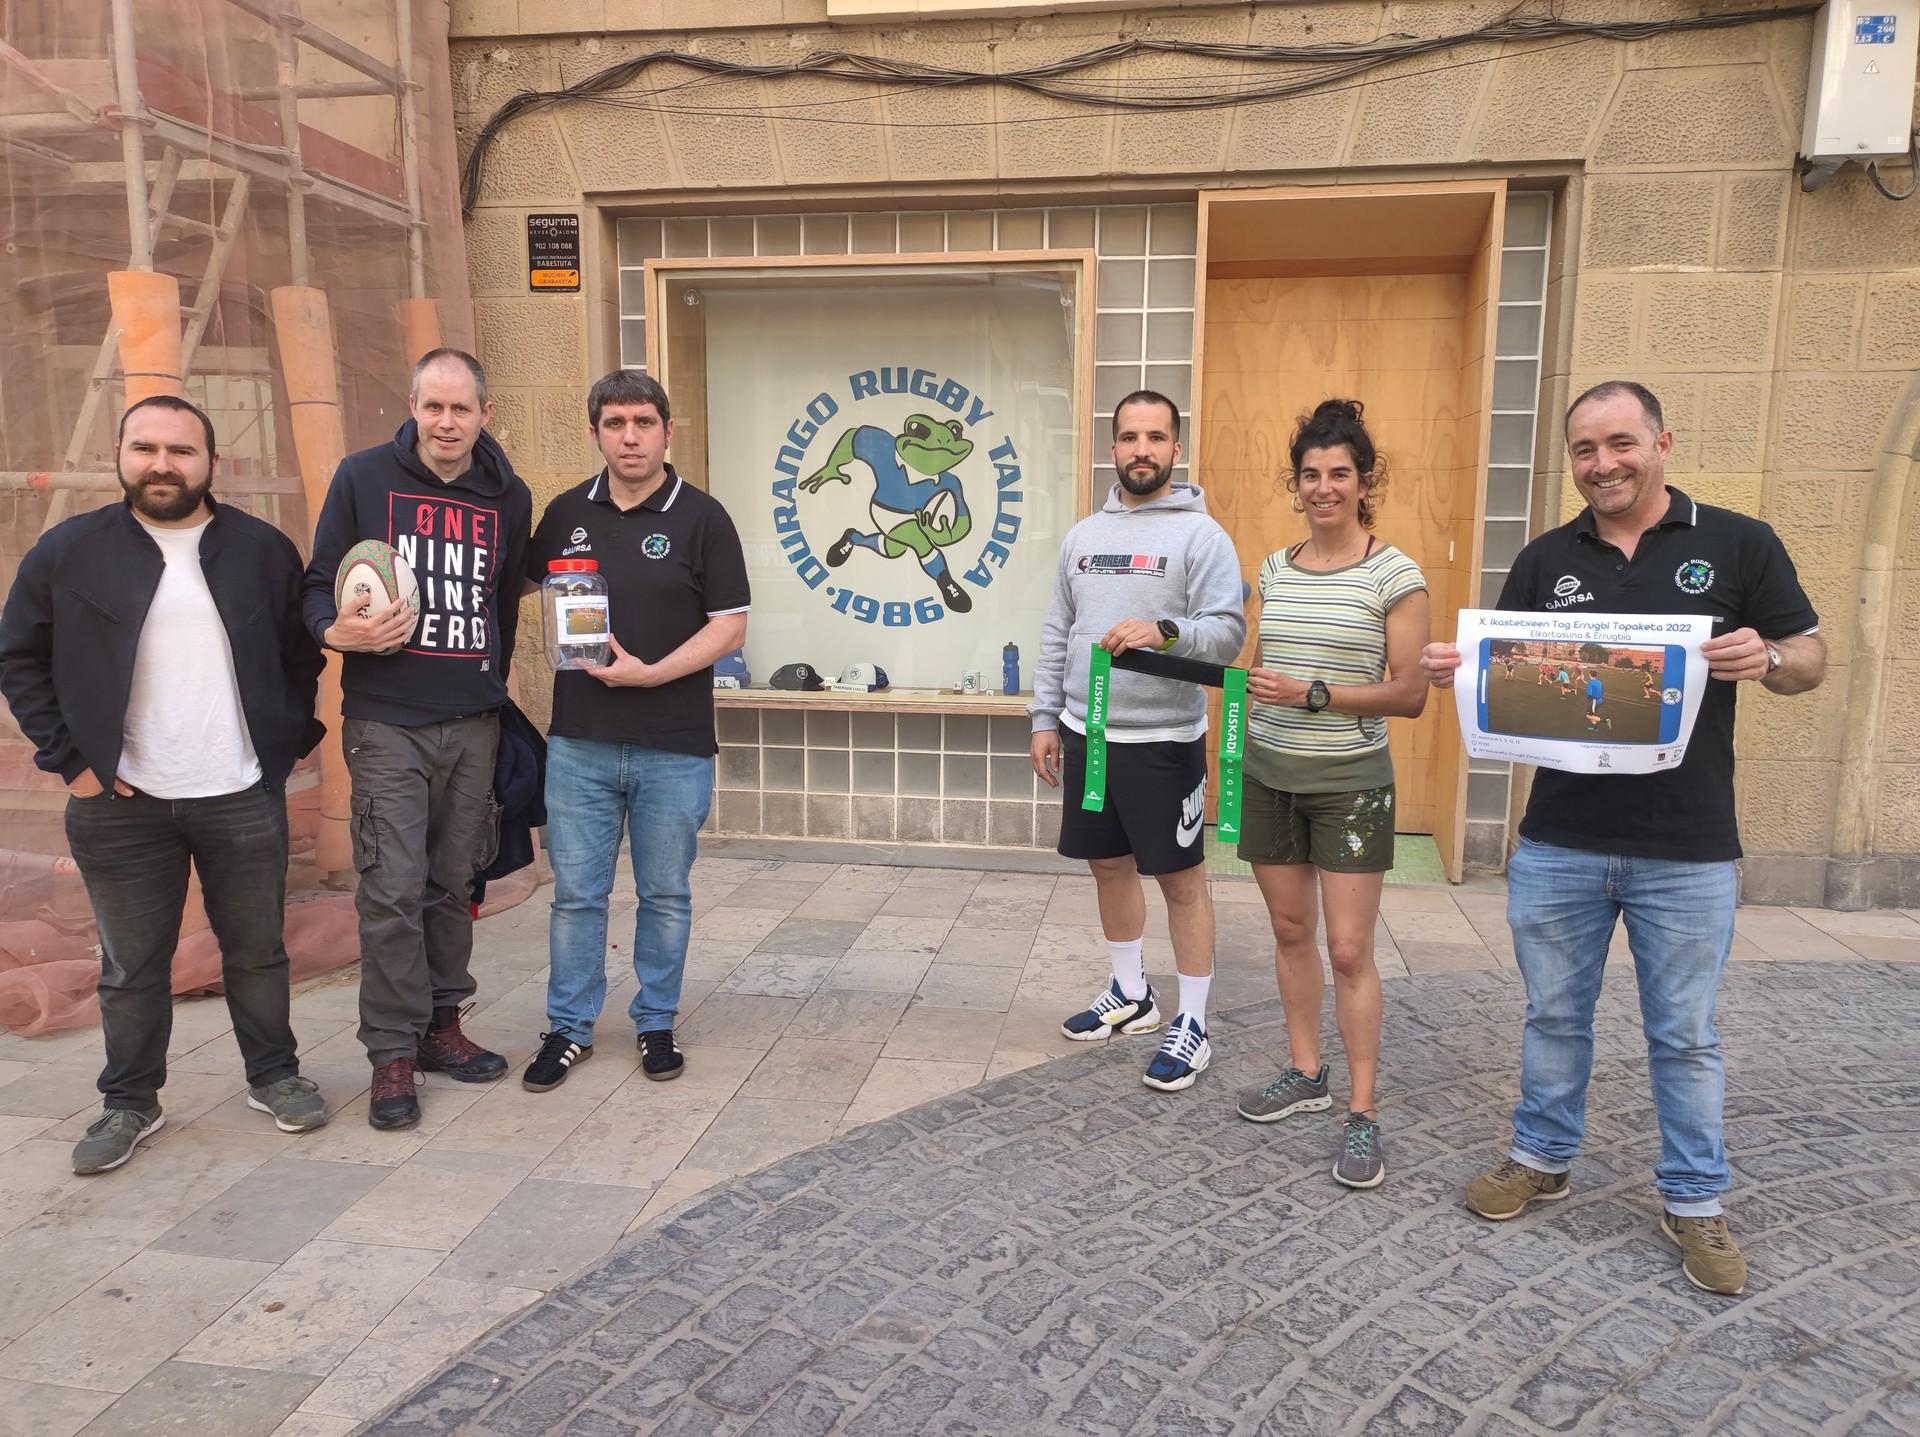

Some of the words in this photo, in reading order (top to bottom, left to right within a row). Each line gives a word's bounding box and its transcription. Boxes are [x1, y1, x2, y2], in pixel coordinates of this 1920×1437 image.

[1877, 25, 1895, 33] 260
[529, 218, 578, 229] segurma
[772, 392, 839, 590] DURANGO
[849, 367, 995, 427] RUGBY
[962, 435, 1023, 588] TALDEA
[399, 534, 487, 581] NINE
[562, 544, 592, 556] GAURSA
[427, 577, 484, 613] INE
[1556, 581, 1578, 592] NISSAN
[831, 588, 945, 627] 1986
[1545, 591, 1595, 610] GAURSA
[1490, 618, 1550, 628] Ikastetxeen
[1553, 620, 1571, 630] Tag
[1573, 621, 1610, 632] Errugbi
[1612, 622, 1664, 633] Topaketa
[1665, 623, 1692, 633] 2022
[1530, 630, 1584, 639] Elkartasuna
[1585, 632, 1592, 640] &
[1593, 632, 1632, 642] Errugbia
[1092, 675, 1104, 725] EUSKADI
[1226, 702, 1239, 754] EUSKADI
[1226, 758, 1234, 807] RUGBY
